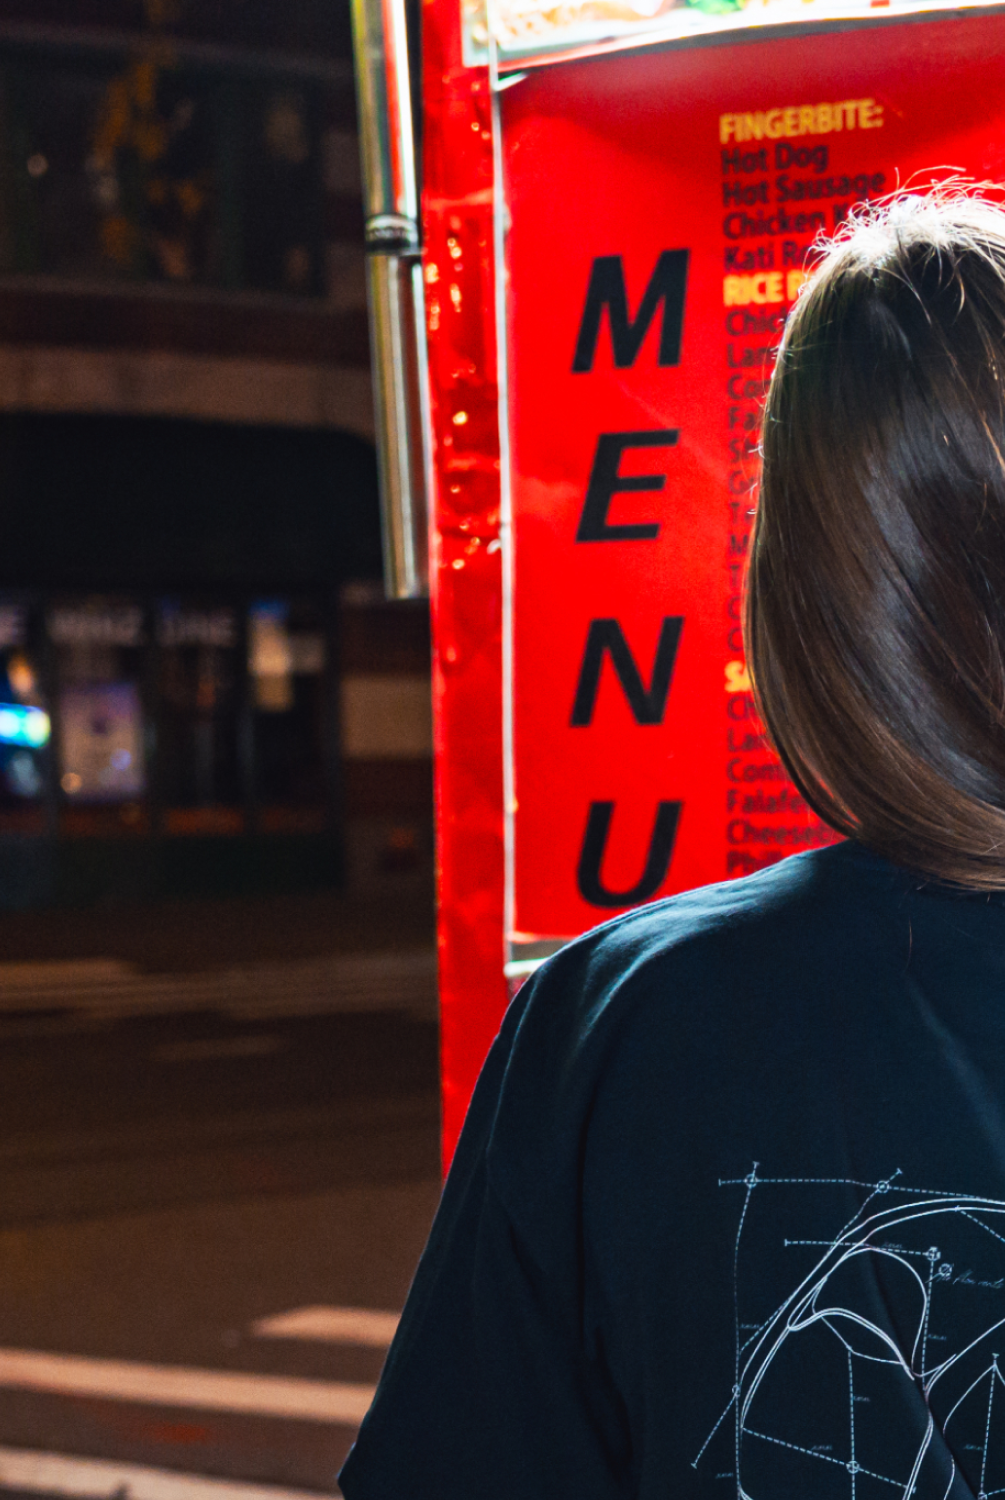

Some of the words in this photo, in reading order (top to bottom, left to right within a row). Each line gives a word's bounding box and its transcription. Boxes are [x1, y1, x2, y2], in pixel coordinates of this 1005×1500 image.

[719, 98, 884, 144] FINGERBITE:
[722, 146, 767, 175] Hot
[774, 142, 829, 173] Dog
[722, 180, 768, 208] Hot
[775, 172, 887, 203] Sausage
[722, 207, 826, 240] Chicken
[724, 244, 774, 273] Kati
[722, 272, 784, 306] RICE
